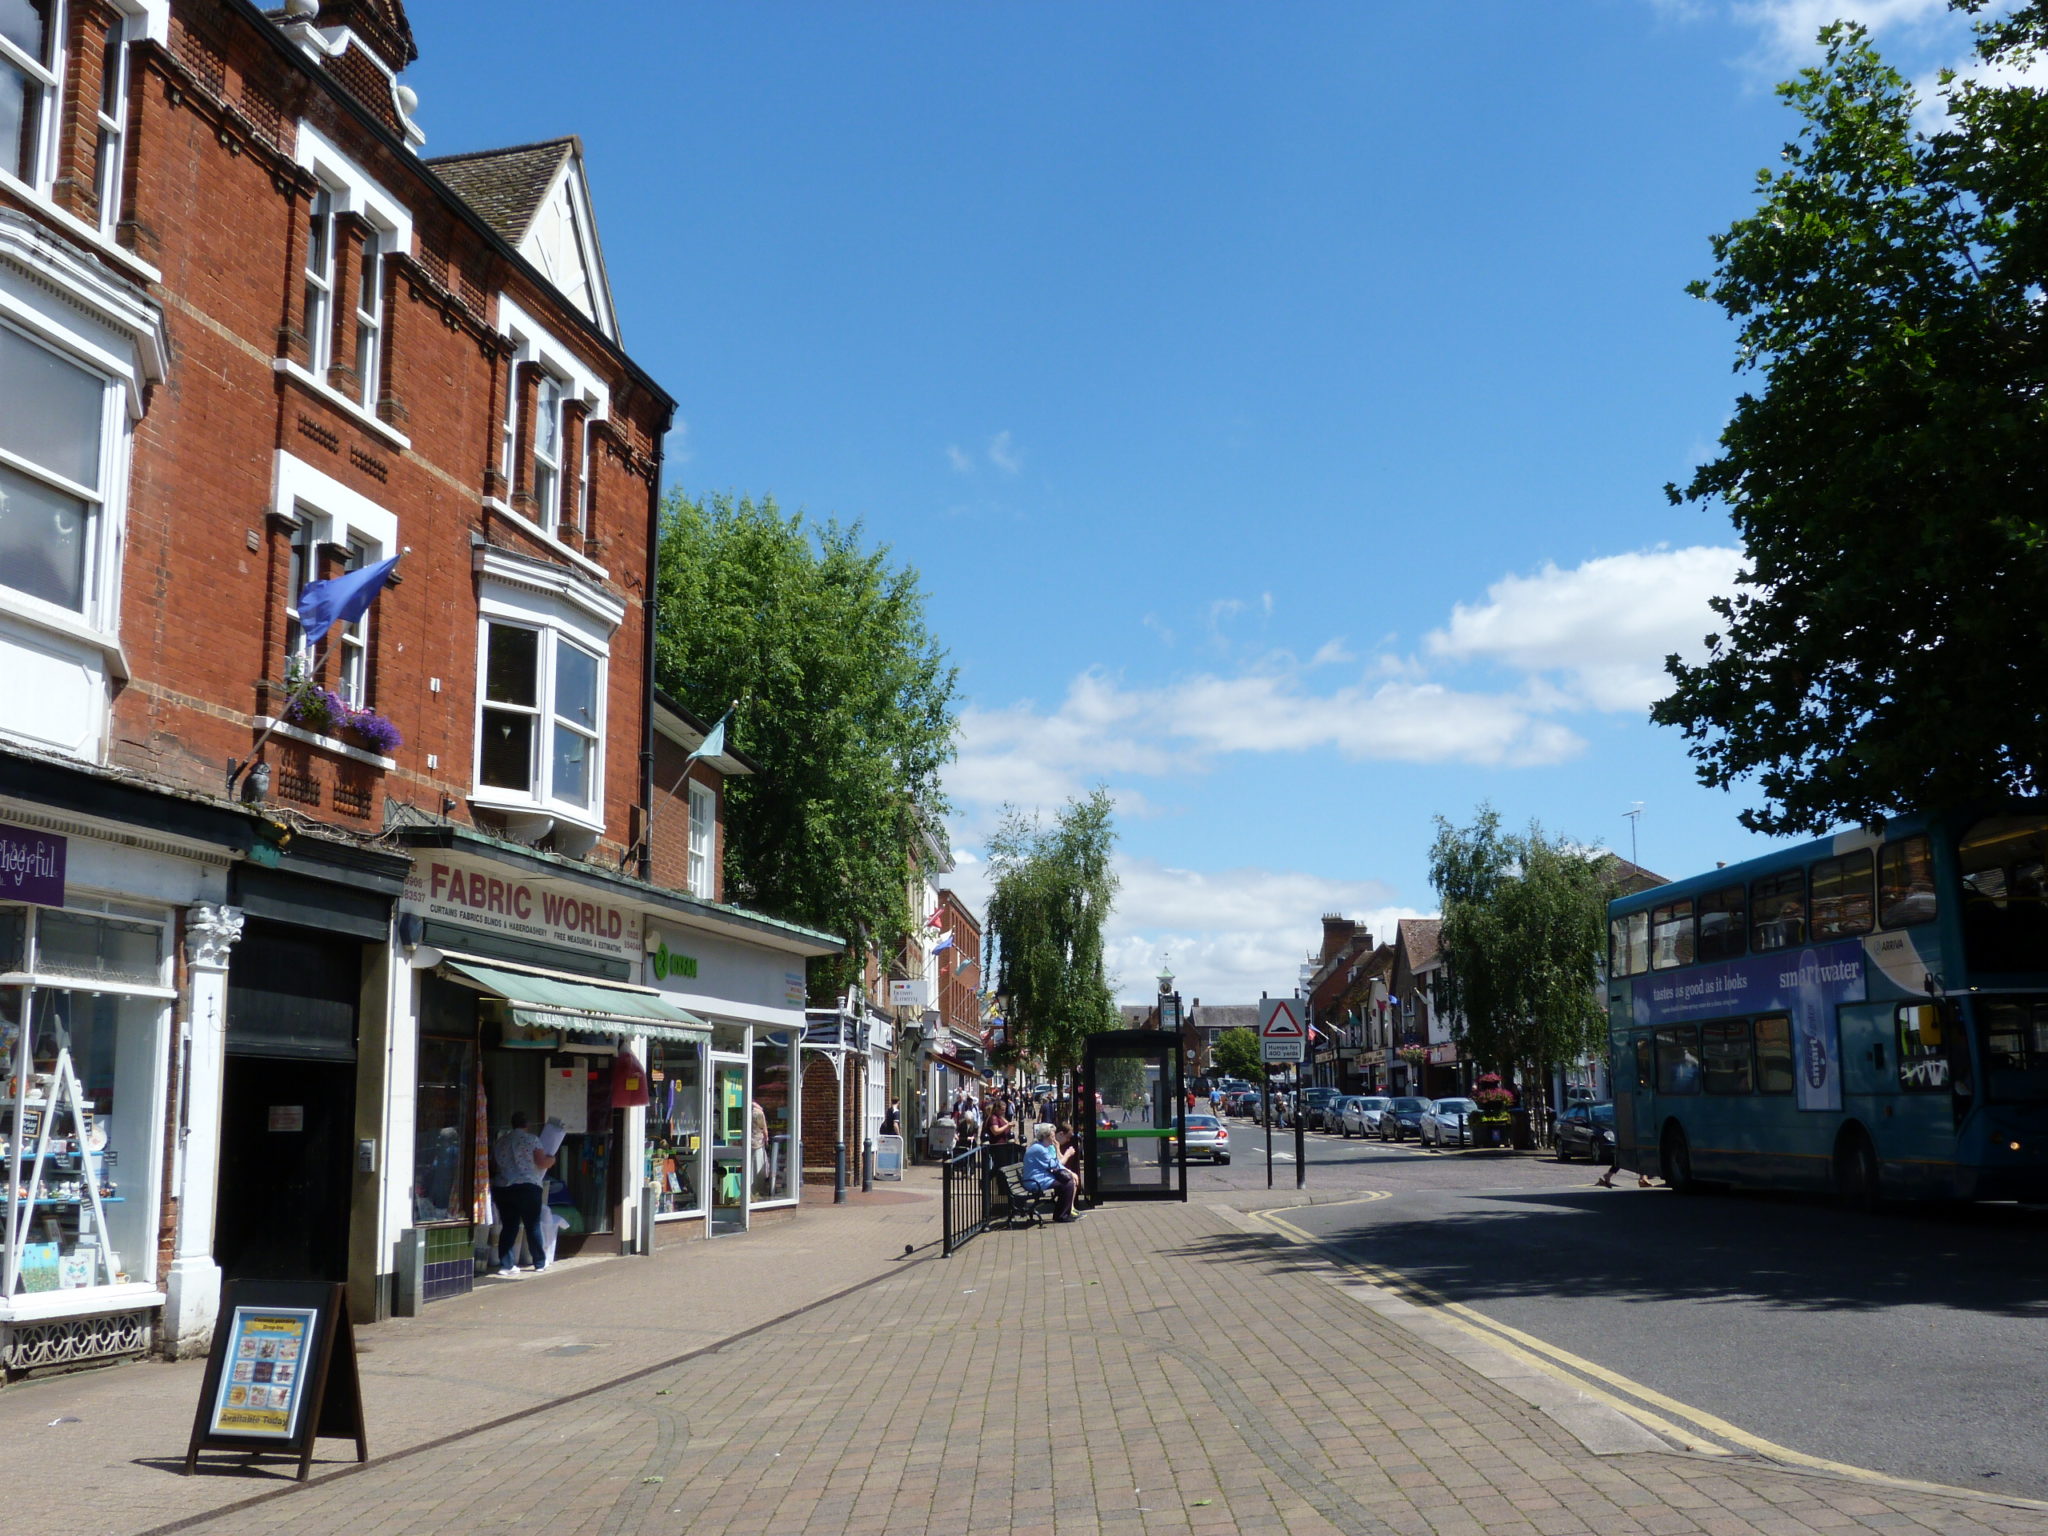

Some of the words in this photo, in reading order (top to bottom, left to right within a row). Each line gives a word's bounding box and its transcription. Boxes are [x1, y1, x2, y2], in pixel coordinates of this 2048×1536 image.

[0, 840, 55, 877] heerful
[431, 863, 532, 920] FABRIC
[542, 892, 622, 939] WORLD
[430, 904, 458, 918] CURTAINS
[459, 910, 483, 924] FABRICS
[484, 916, 502, 929] BLINDS
[554, 931, 566, 941] FREE
[1881, 939, 1904, 951] ARRIVA
[1653, 987, 1674, 1001] tastes
[1675, 985, 1684, 998] as
[1685, 979, 1704, 1000] good
[1705, 981, 1715, 994] as
[1716, 976, 1722, 992] it
[1724, 973, 1748, 991] looks
